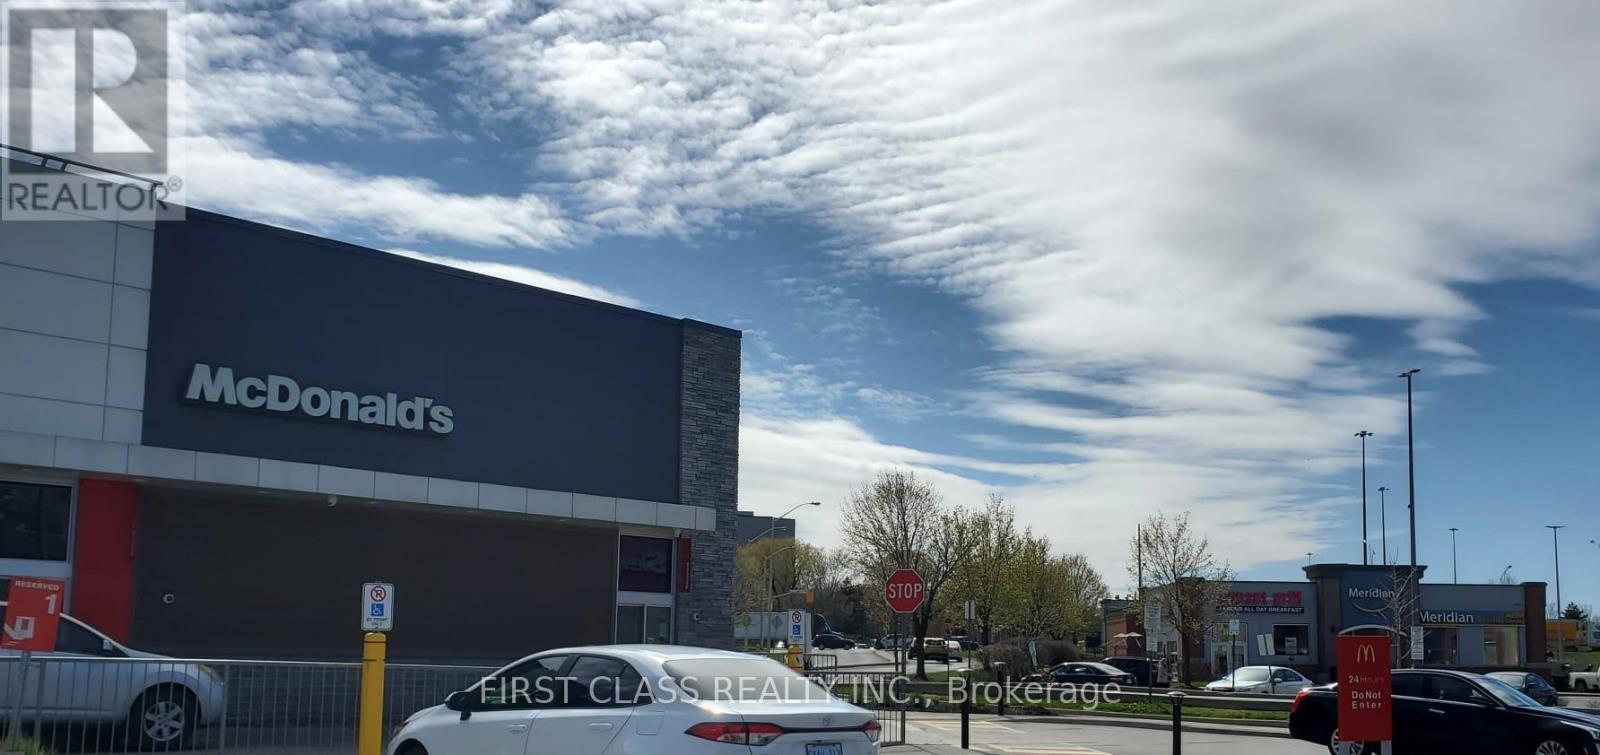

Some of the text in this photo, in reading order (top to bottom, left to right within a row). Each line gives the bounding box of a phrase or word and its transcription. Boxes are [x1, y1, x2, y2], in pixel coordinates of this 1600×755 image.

[186, 363, 454, 434] McDonald's
[15, 580, 60, 591] RESERVED
[888, 583, 923, 599] STOP
[1348, 587, 1395, 599] Meridian
[45, 593, 57, 615] 1
[1420, 611, 1474, 624] Meridian
[1348, 675, 1359, 684] 24
[1352, 689, 1382, 699] Do Not
[1352, 701, 1382, 709] Enter
